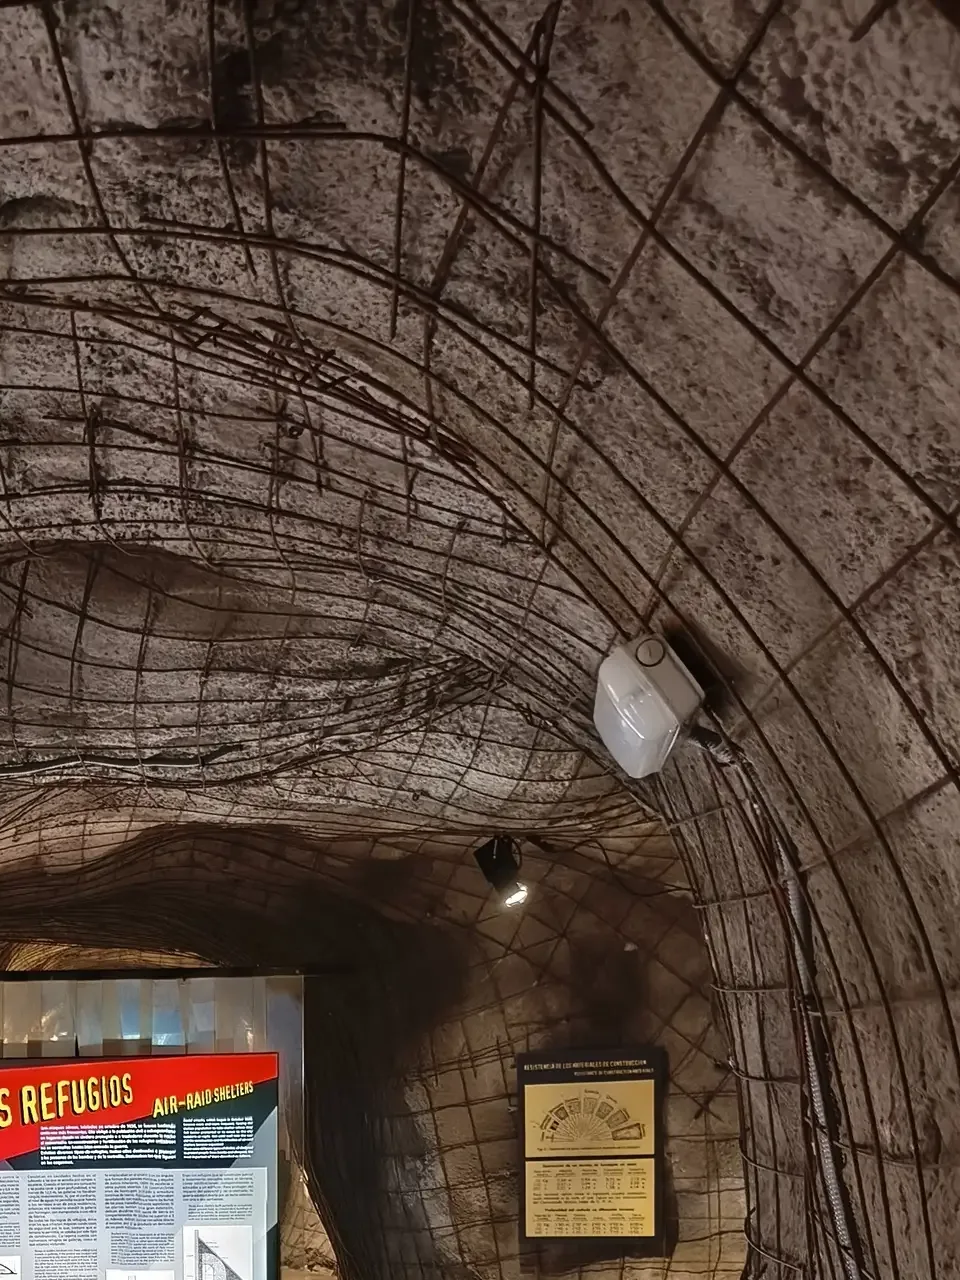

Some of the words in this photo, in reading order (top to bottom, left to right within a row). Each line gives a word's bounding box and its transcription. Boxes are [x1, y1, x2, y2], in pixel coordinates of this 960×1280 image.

[19, 1072, 134, 1126] REFUGIOS
[152, 1090, 212, 1118] AIR-RAID
[213, 1081, 254, 1103] SHELTERS
